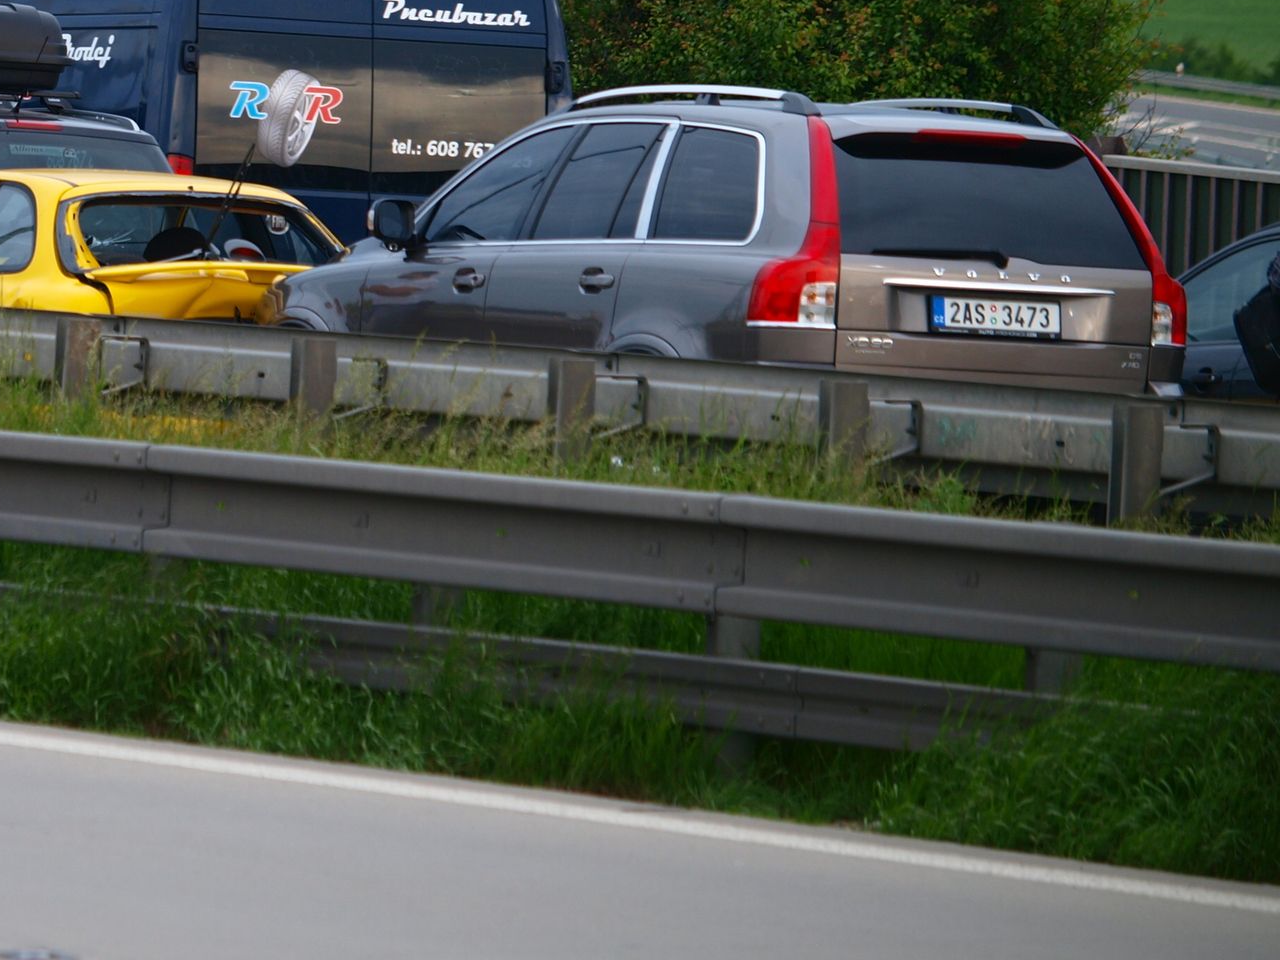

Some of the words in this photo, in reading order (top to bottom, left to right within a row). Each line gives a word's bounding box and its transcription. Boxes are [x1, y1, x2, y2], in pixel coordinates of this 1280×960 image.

[230, 80, 269, 119] R
[304, 86, 343, 123] R
[391, 139, 422, 155] tel.:
[426, 140, 459, 158] 608
[932, 266, 1072, 284] VOLVO
[934, 315, 945, 324] CZ
[950, 302, 986, 326] 2AS
[1002, 305, 1051, 329] 3473
